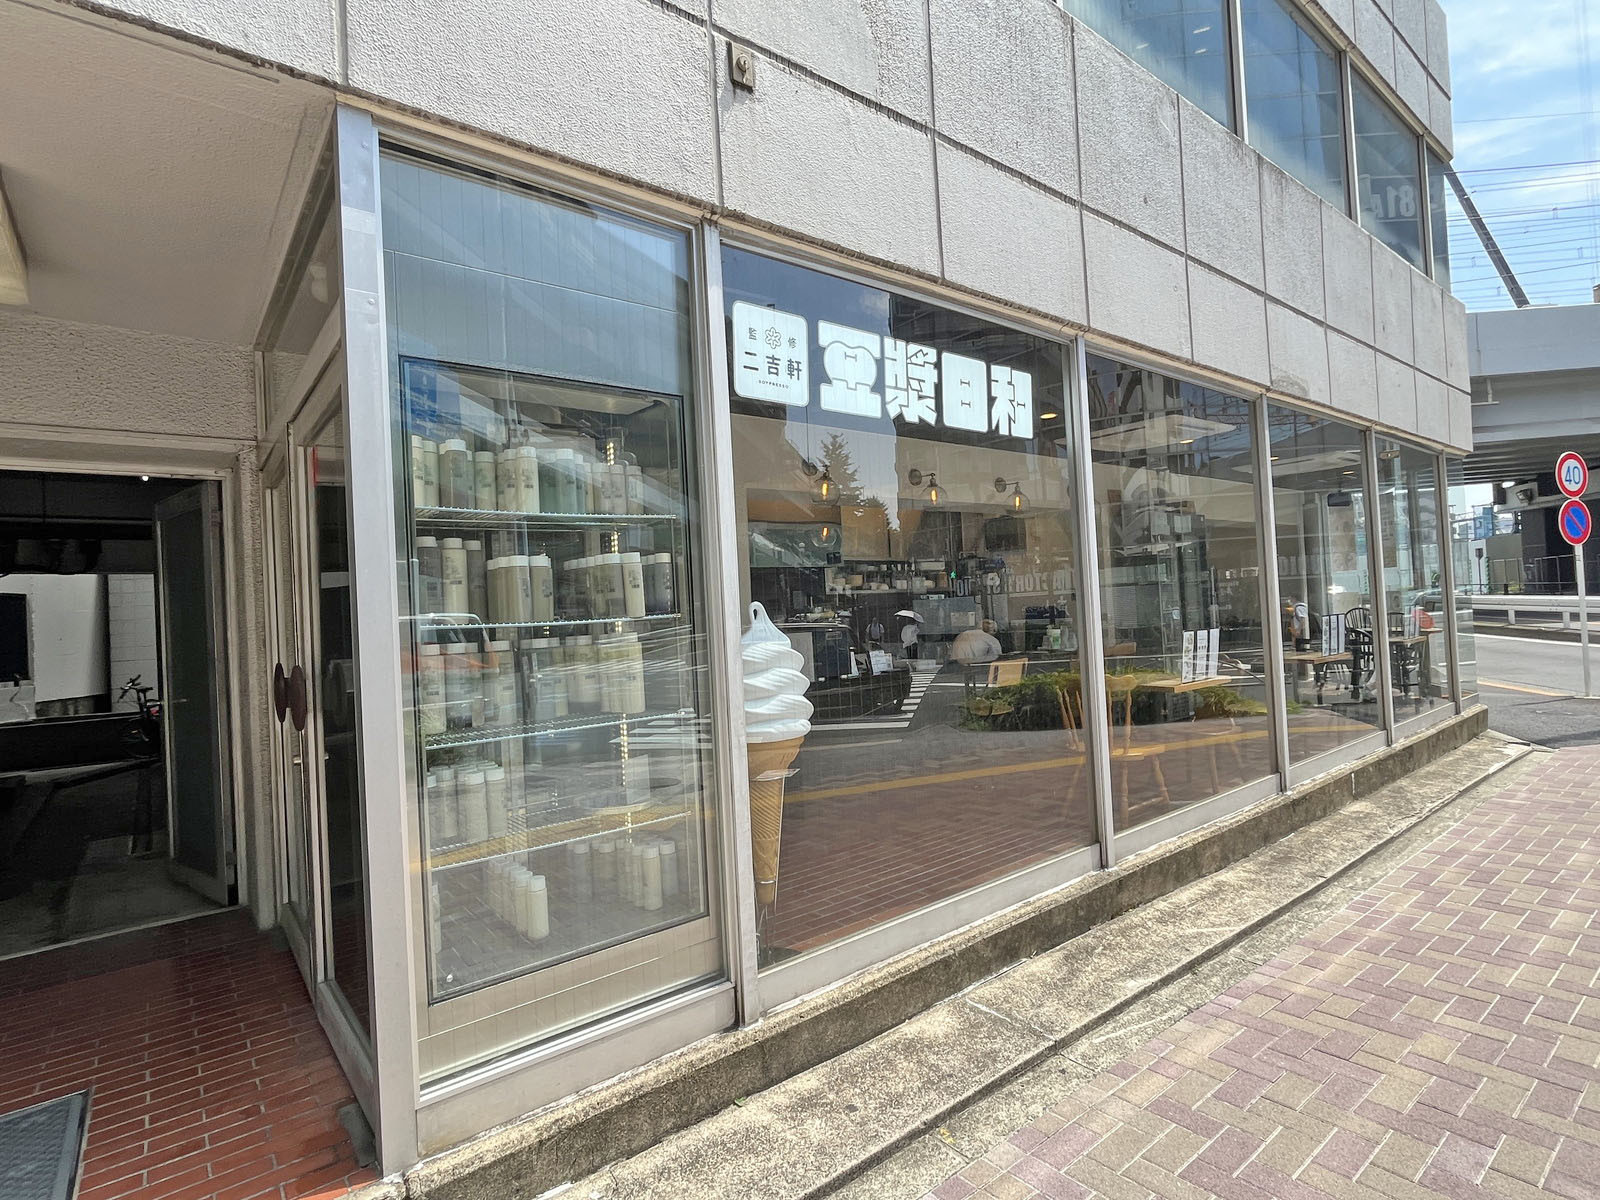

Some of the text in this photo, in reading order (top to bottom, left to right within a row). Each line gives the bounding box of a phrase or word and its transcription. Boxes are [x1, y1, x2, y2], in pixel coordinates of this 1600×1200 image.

[743, 351, 803, 381] 二吉軒
[758, 379, 790, 390] SOYPRESSO
[1564, 465, 1581, 486] 40
